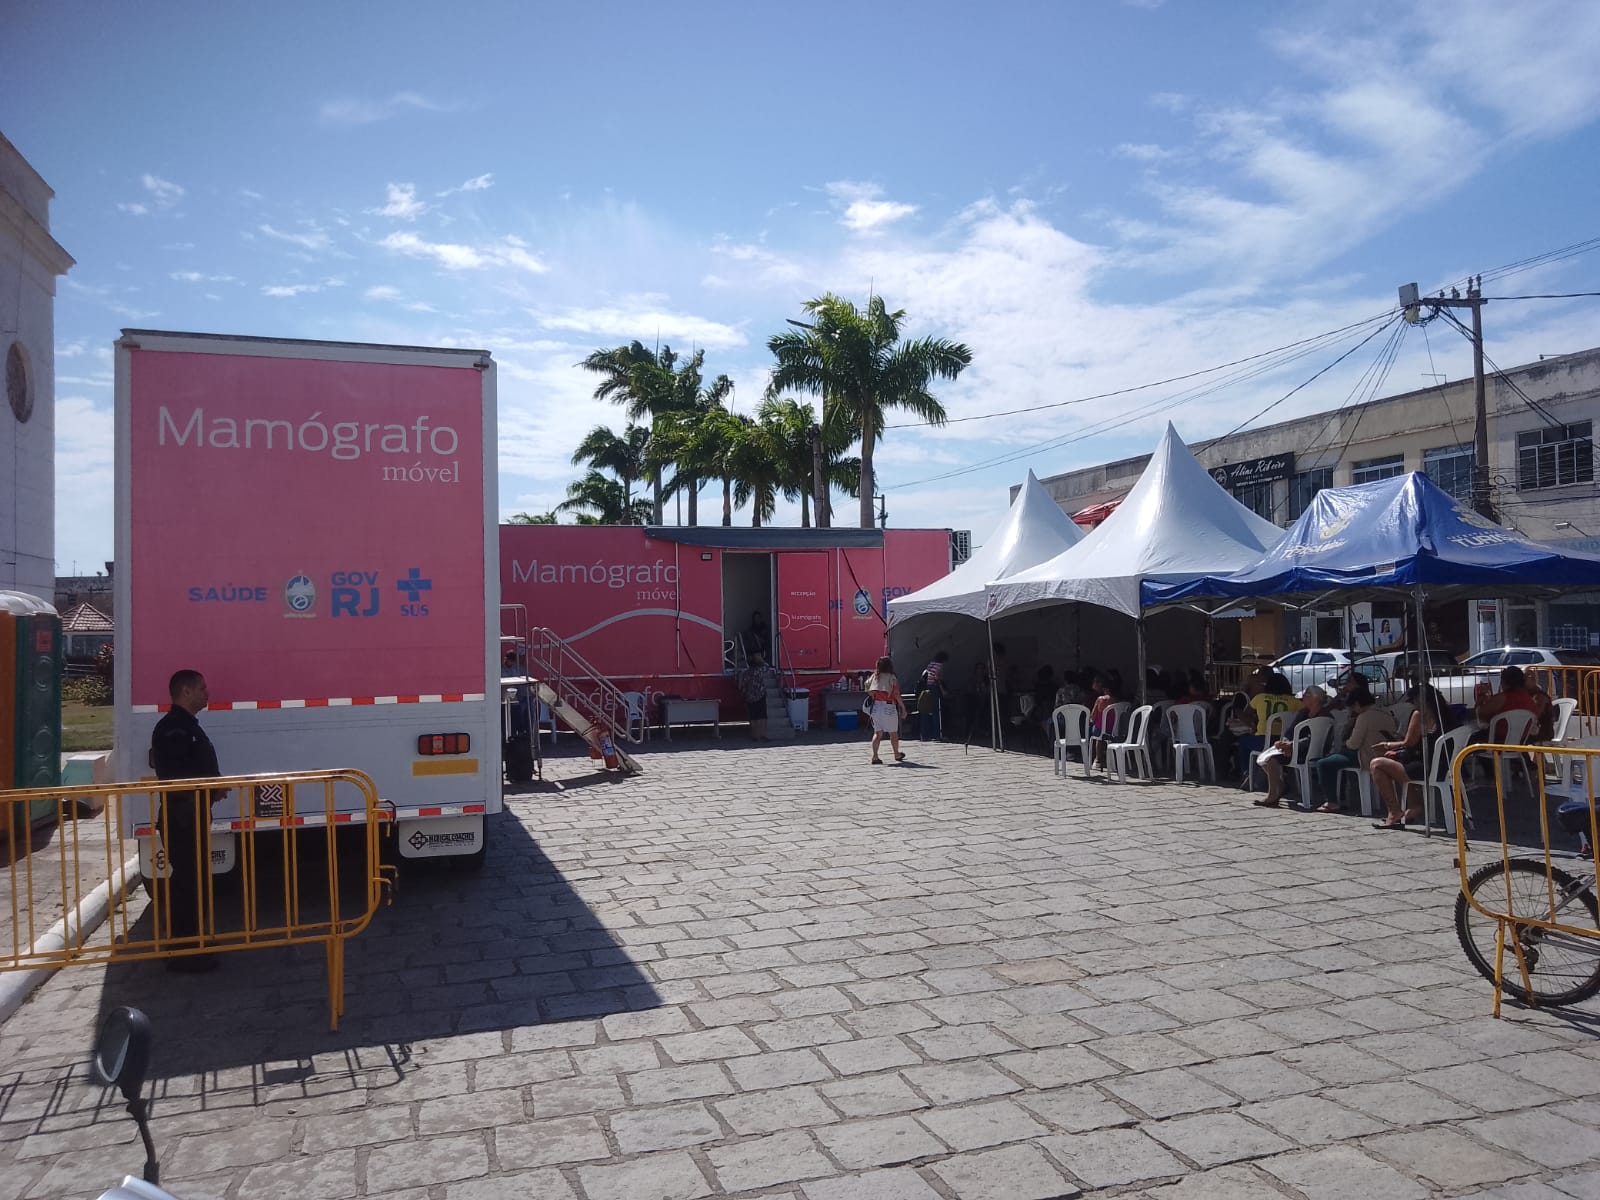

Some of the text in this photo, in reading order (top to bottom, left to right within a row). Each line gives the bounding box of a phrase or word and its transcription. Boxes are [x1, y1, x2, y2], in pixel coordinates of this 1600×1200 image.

[158, 405, 460, 461] Mamógrafo
[382, 461, 460, 483] móvel
[331, 571, 378, 586] GOV
[511, 559, 680, 589] Mamógrafo
[188, 583, 269, 603] SAÚDE
[331, 587, 380, 618] RJ
[636, 587, 680, 601] móve
[400, 604, 430, 617] SUS
